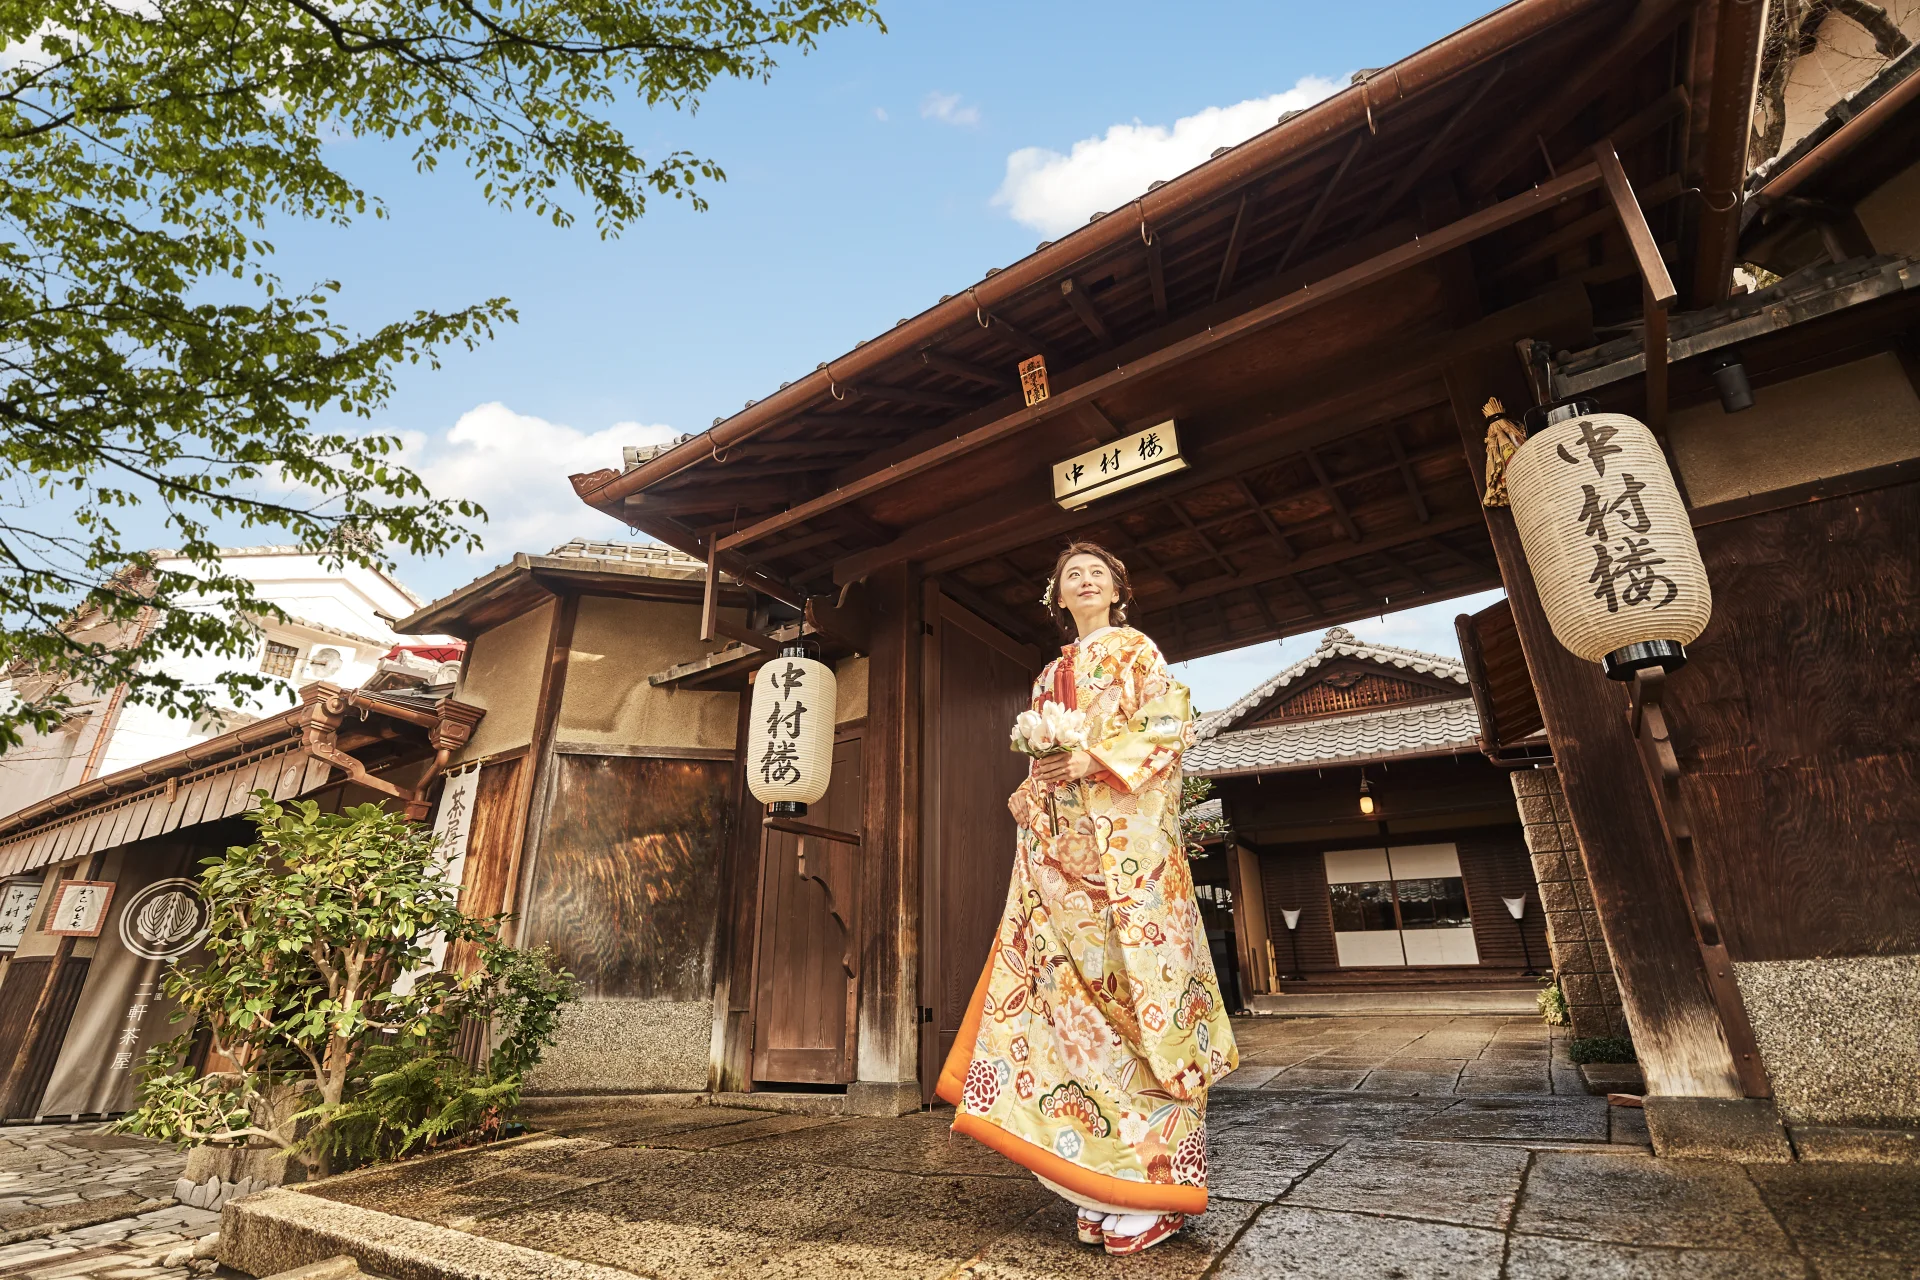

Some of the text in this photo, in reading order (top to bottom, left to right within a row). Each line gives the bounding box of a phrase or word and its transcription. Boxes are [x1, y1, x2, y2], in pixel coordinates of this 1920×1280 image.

[1065, 432, 1163, 486] 中村楼
[1557, 420, 1679, 613] 中村楼
[761, 661, 808, 787] 中村楼
[110, 983, 153, 1070] 二軒茶屋
